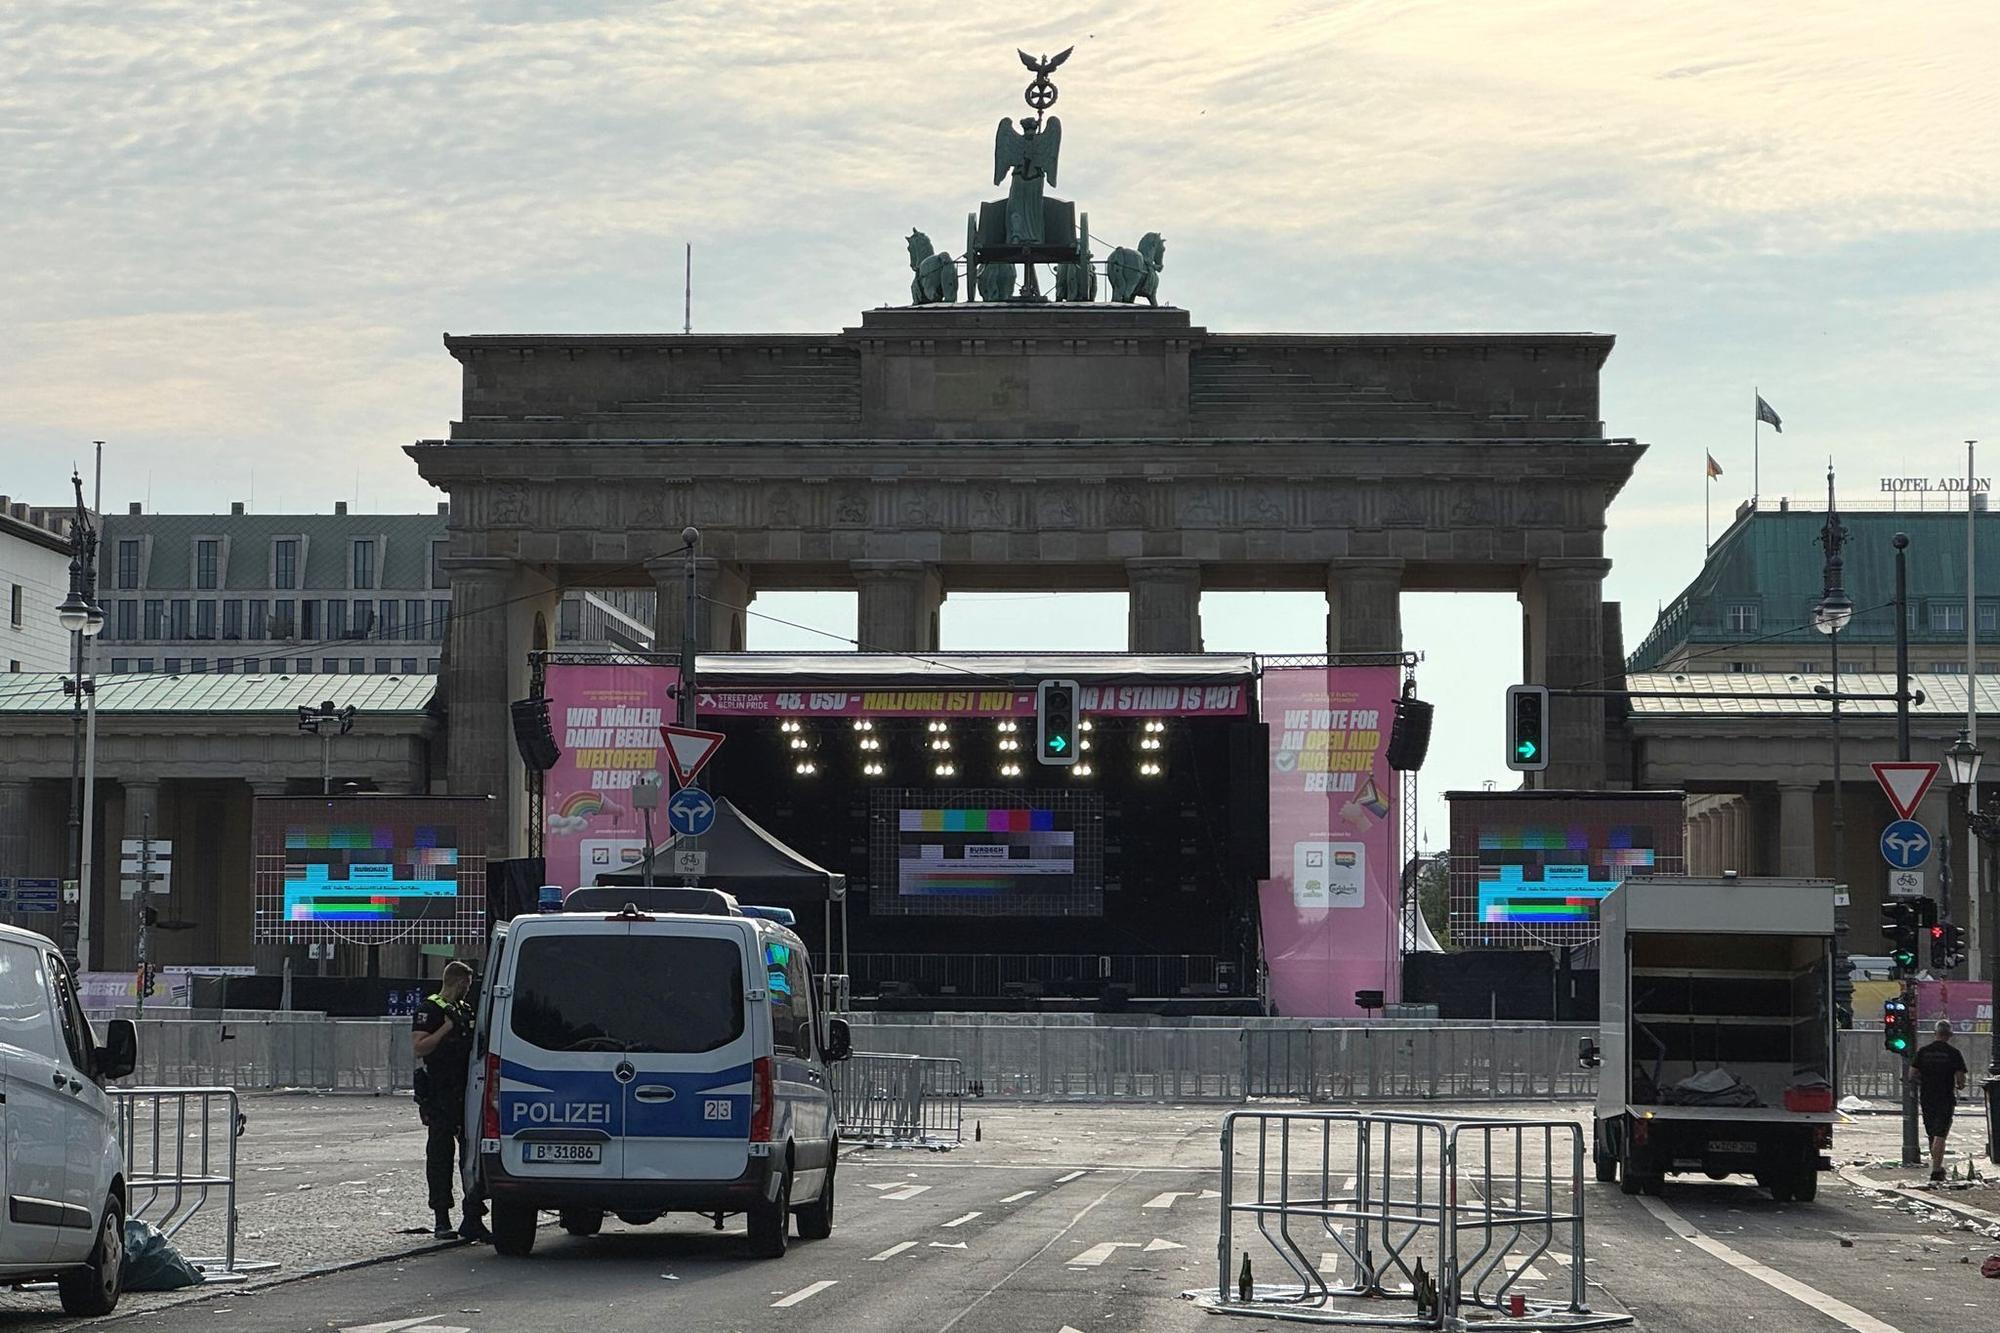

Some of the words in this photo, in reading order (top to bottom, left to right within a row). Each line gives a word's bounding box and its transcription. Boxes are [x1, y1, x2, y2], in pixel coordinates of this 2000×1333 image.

[1880, 478, 1933, 492] HOTEL
[1937, 478, 1991, 492] ADLON
[718, 702, 745, 710] BERLIN
[746, 701, 769, 710] PRIDE
[748, 693, 763, 701] DAY
[809, 693, 848, 710] CSD
[1101, 687, 1115, 710] A
[1118, 686, 1180, 710] STAND
[1182, 686, 1200, 710] IS
[1203, 685, 1241, 709] HOT
[567, 708, 598, 727] WIR
[1284, 710, 1310, 729] WE
[1311, 710, 1349, 729] VOTE
[1349, 710, 1379, 729] FOR
[565, 728, 614, 748] DAMIT
[1280, 731, 1305, 750] AN
[1305, 731, 1347, 750] OPEN
[1347, 731, 1381, 750] AND
[576, 749, 658, 769] WELTOFFEN
[1297, 752, 1375, 772] INCLUSIVE
[1304, 772, 1357, 792] BERLIN
[512, 1102, 610, 1123] POLIZEI
[706, 1101, 730, 1118] 23
[537, 1145, 546, 1159] B
[554, 1145, 594, 1159] 31886
